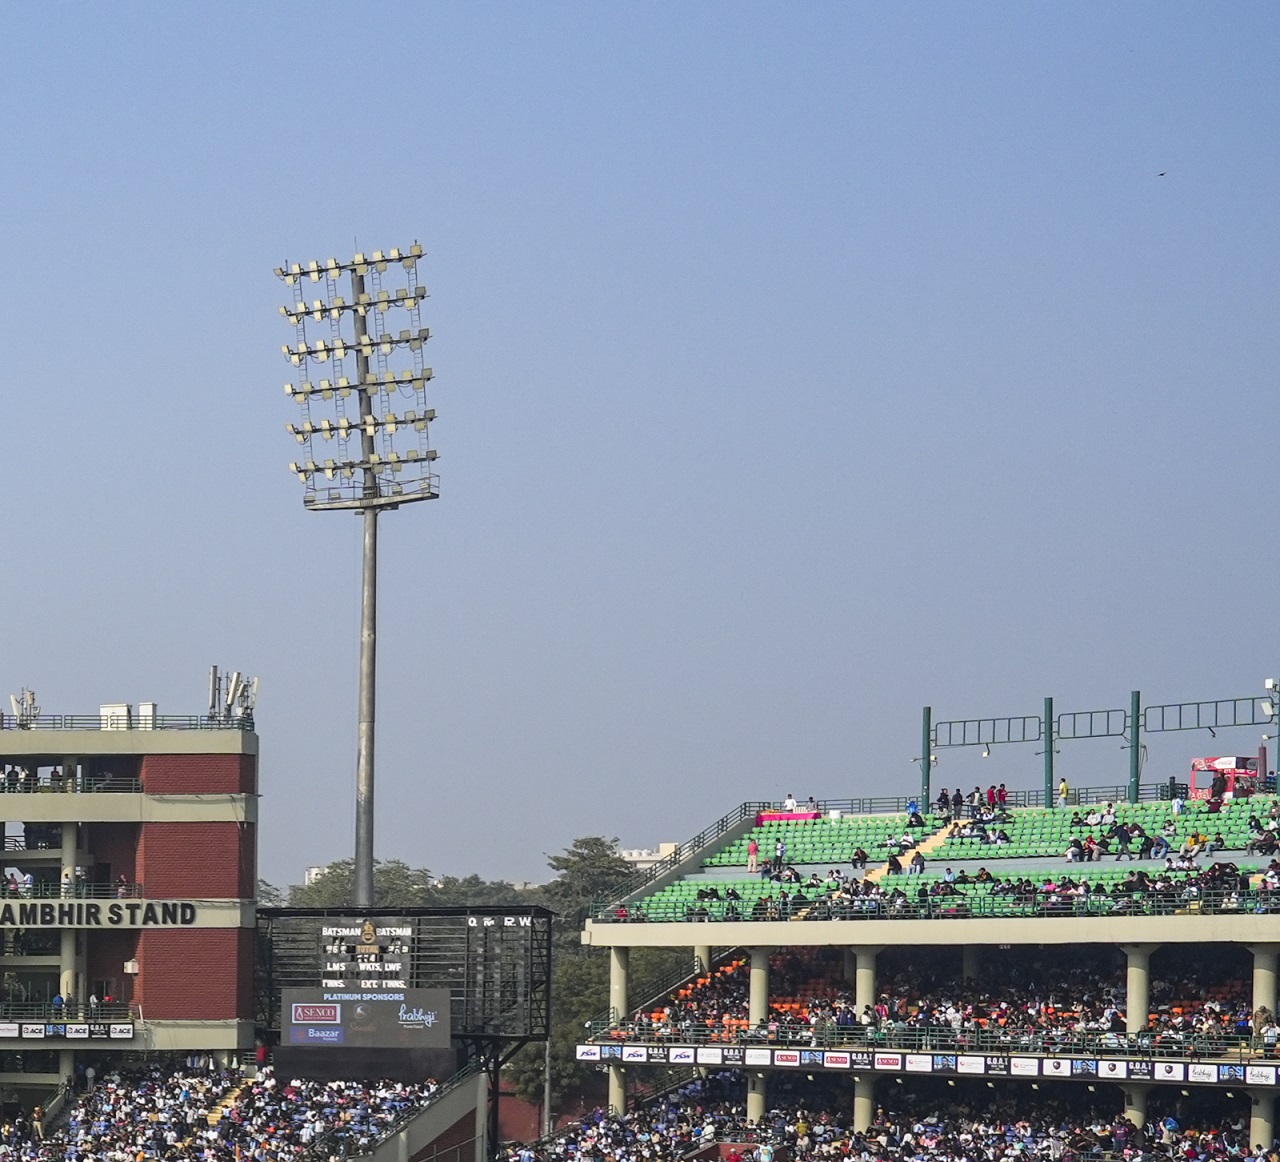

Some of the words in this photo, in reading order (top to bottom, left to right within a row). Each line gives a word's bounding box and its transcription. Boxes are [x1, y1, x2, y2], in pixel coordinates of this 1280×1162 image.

[108, 903, 197, 925] STAND
[322, 927, 361, 936] BATSMAN
[376, 927, 412, 936] BATSMAN
[327, 963, 345, 971] LMS
[304, 1007, 334, 1017] SENCO
[308, 1029, 339, 1037] Baazar
